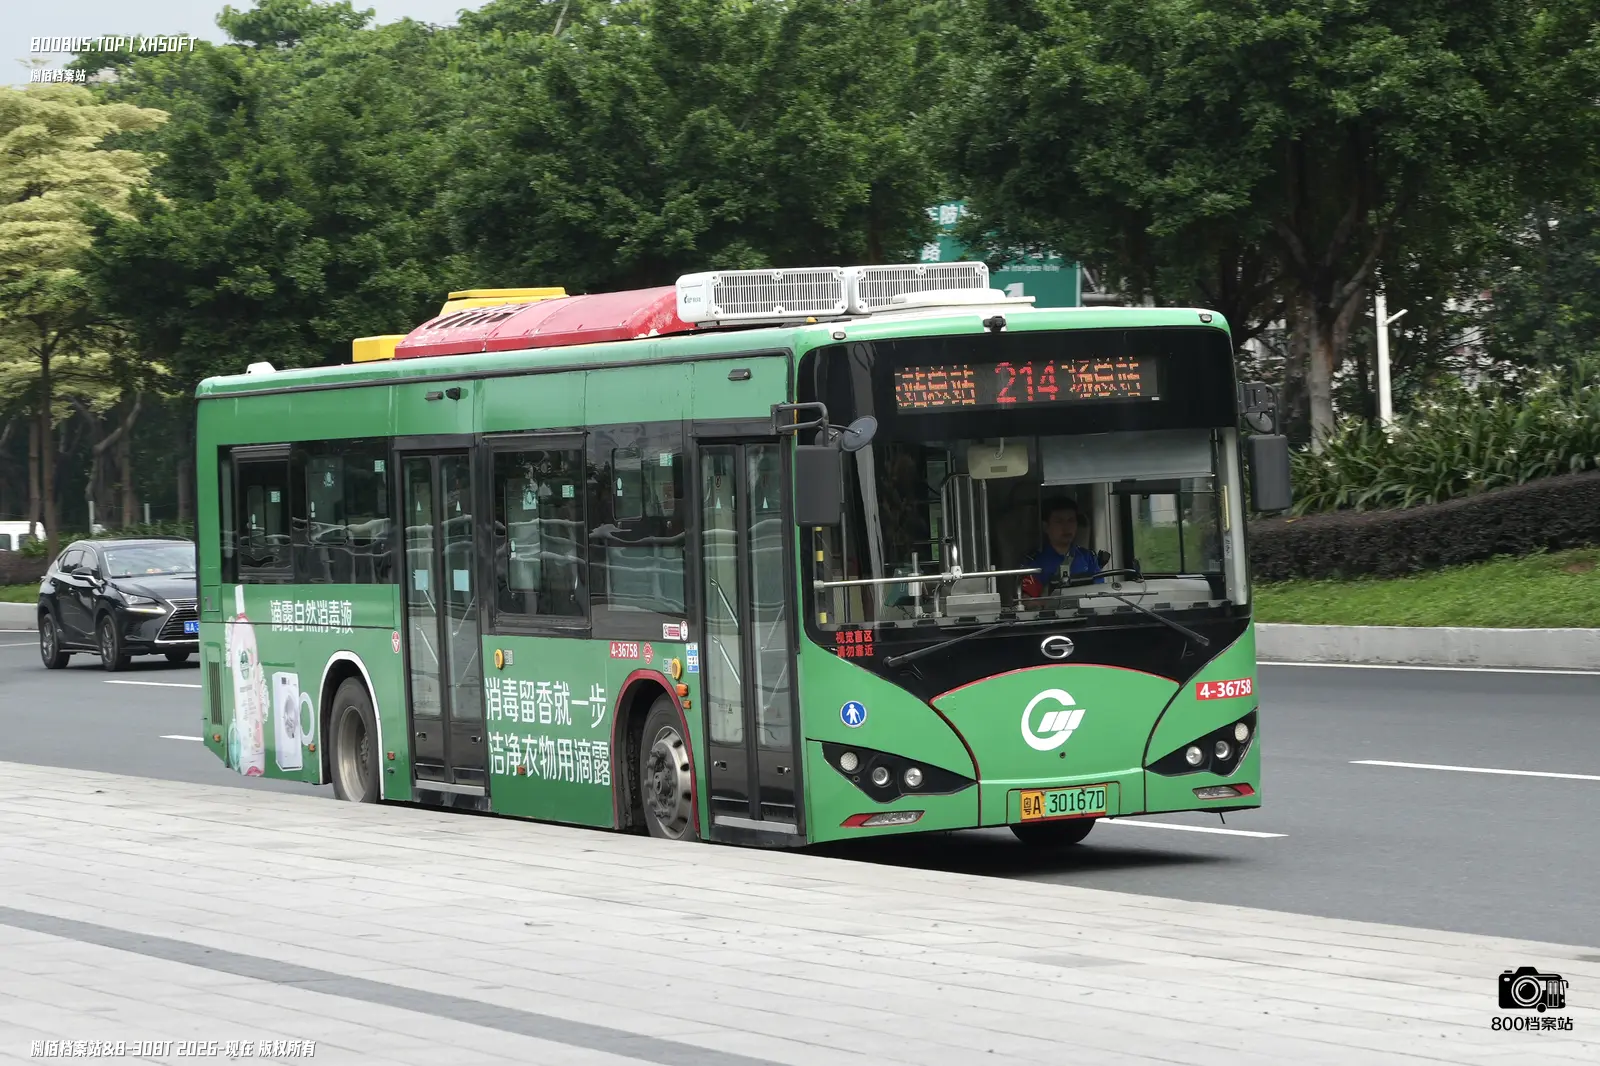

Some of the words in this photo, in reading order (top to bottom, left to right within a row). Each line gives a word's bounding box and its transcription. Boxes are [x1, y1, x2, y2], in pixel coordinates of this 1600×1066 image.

[995, 361, 1059, 403] 214
[270, 599, 354, 634] 滴露自然消毒液
[836, 629, 873, 644] 视觉盲区
[611, 643, 638, 658] 4-36758
[837, 644, 874, 658] 请勿靠近
[1200, 679, 1252, 698] 4-36758
[485, 677, 607, 728] 消毒留香就一步
[488, 731, 611, 786] 洁净衣物用滴露
